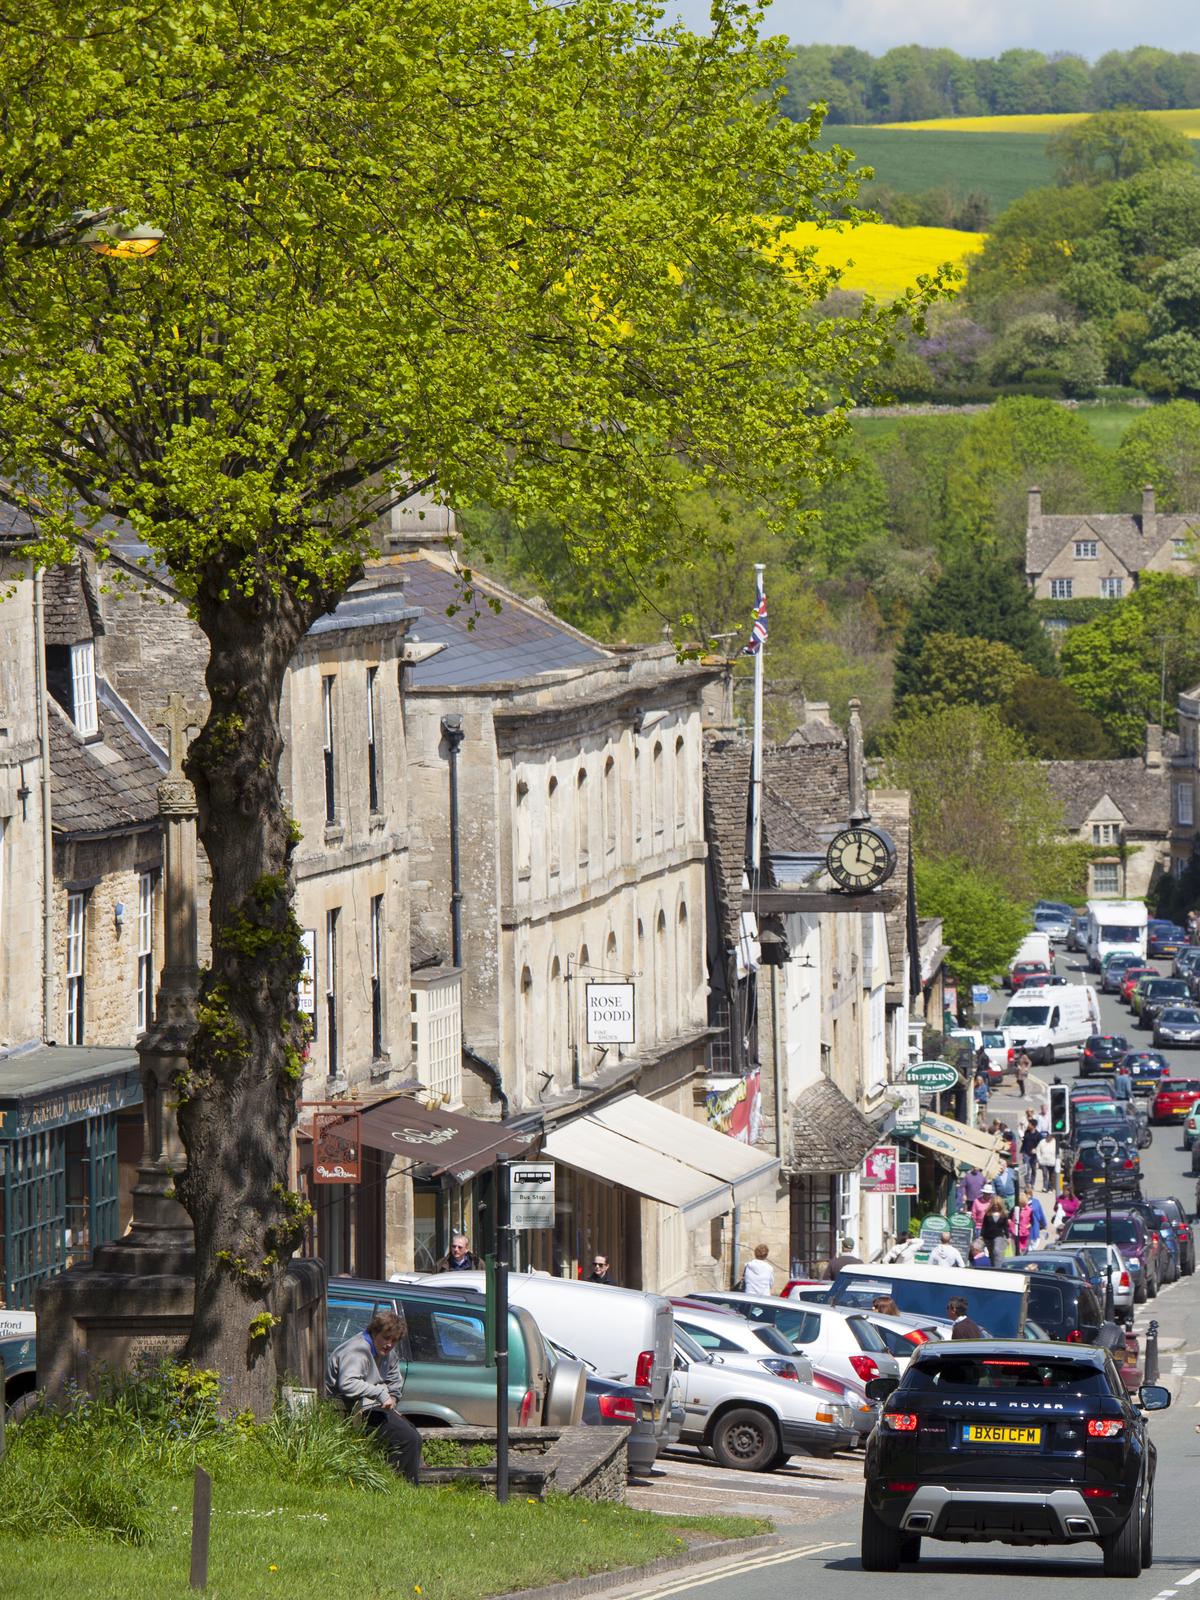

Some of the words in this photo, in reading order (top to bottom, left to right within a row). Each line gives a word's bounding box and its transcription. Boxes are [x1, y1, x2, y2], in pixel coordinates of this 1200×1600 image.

[591, 997, 622, 1007] ROSE
[593, 1010, 631, 1021] DODD
[907, 1072, 954, 1081] HUFFKINS
[33, 1096, 65, 1125] BURFORD
[67, 1083, 111, 1113] WOODCRAFT
[974, 1426, 1005, 1441] BX61
[1009, 1428, 1035, 1442] CFM
